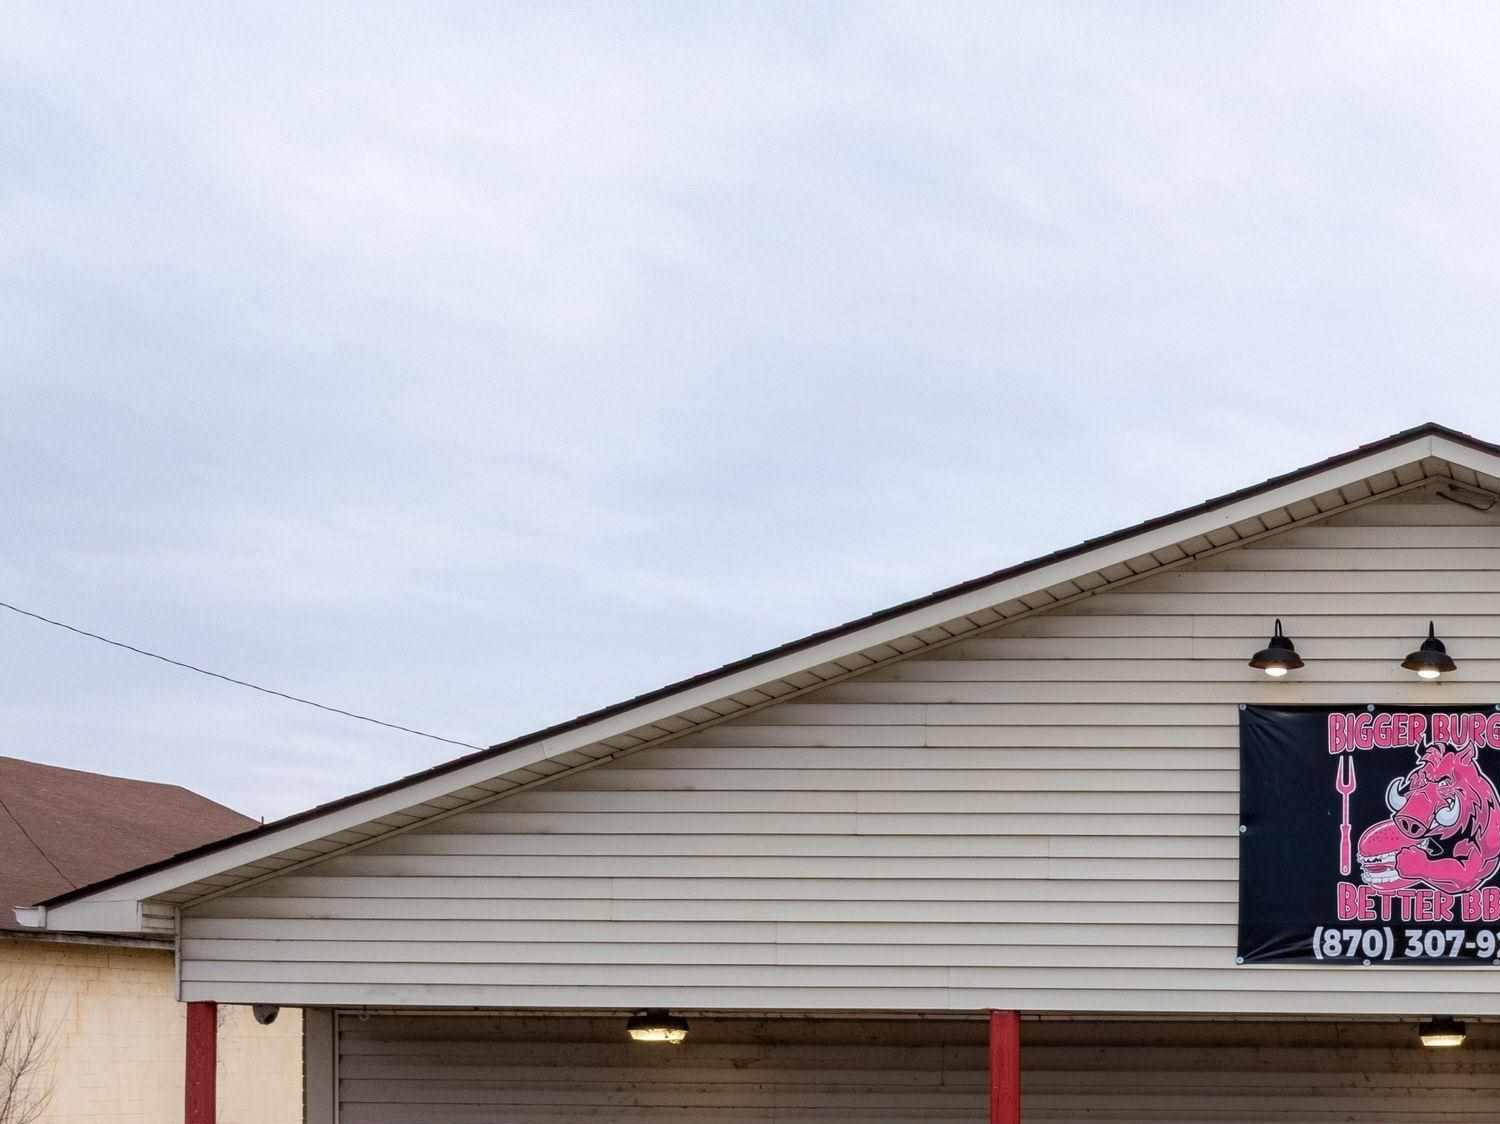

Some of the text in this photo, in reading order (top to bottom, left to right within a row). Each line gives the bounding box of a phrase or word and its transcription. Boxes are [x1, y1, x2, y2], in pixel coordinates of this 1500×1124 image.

[1328, 713, 1427, 755] BIGGER
[1338, 882, 1454, 922] BETTER
[1313, 926, 1394, 960] (870)
